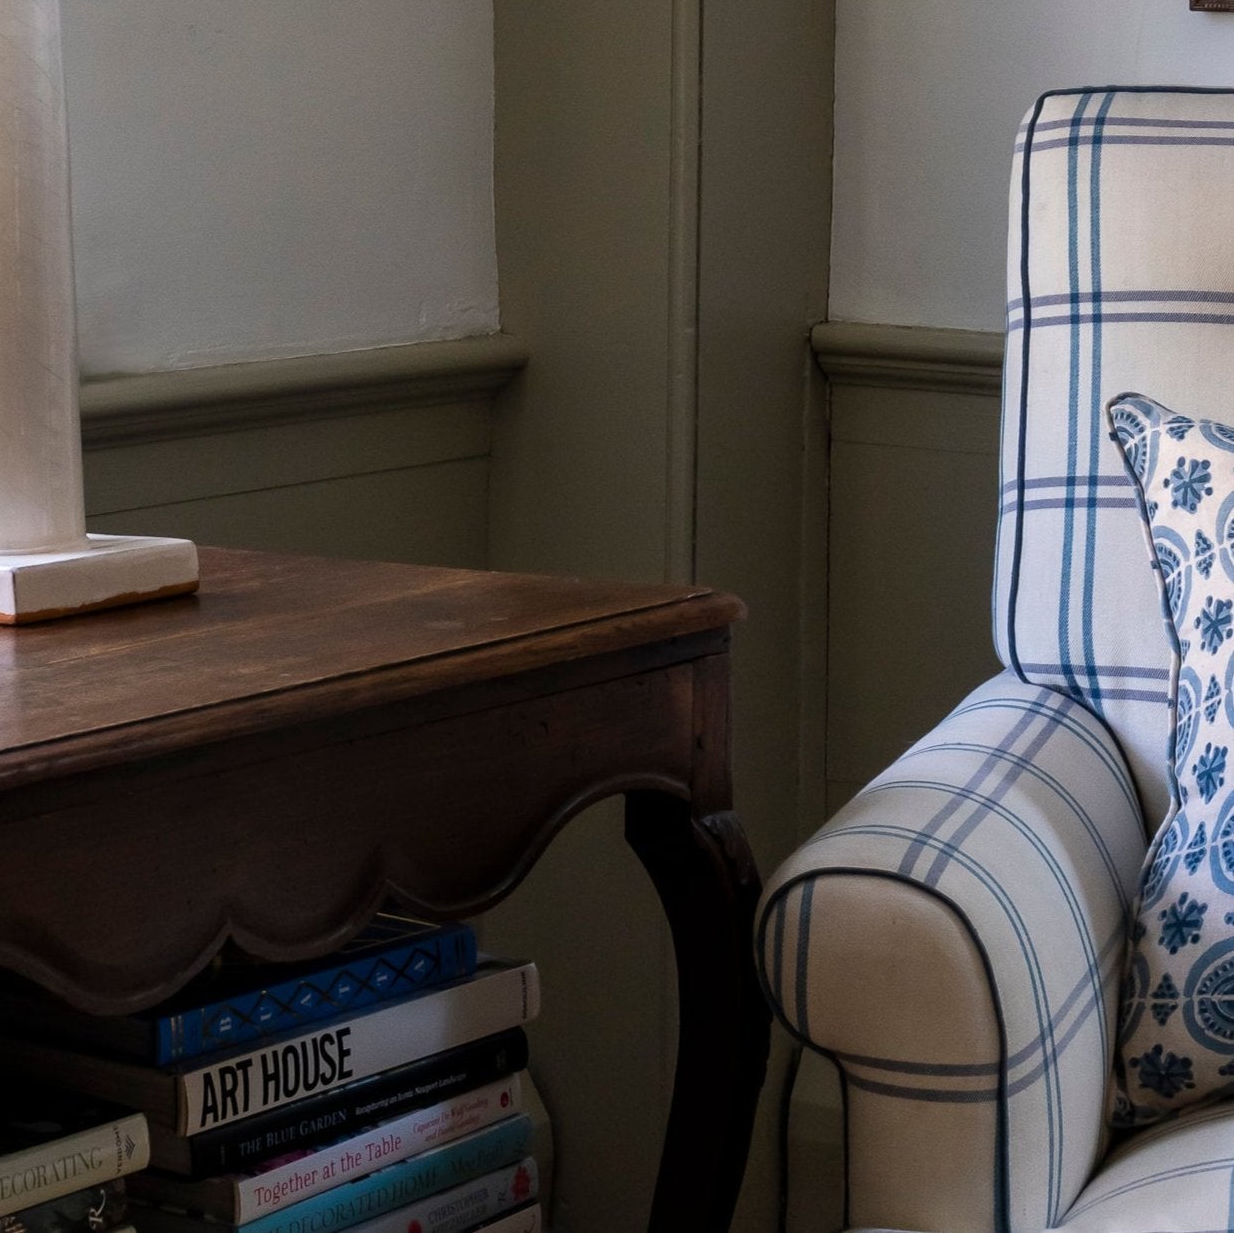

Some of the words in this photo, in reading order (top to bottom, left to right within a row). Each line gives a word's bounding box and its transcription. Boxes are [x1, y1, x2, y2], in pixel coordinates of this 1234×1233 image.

[200, 1059, 253, 1127] ART
[260, 1026, 354, 1106] HOUSE
[239, 1137, 263, 1157] THE
[266, 1126, 297, 1149] BLUE
[298, 1108, 347, 1139] GARDEN
[253, 1168, 318, 1207] Together
[322, 1161, 336, 1180] at
[340, 1151, 362, 1172] the
[365, 1134, 402, 1162] Table
[392, 1166, 439, 1203] HOME
[427, 1187, 489, 1224] CHRISTOPHER
